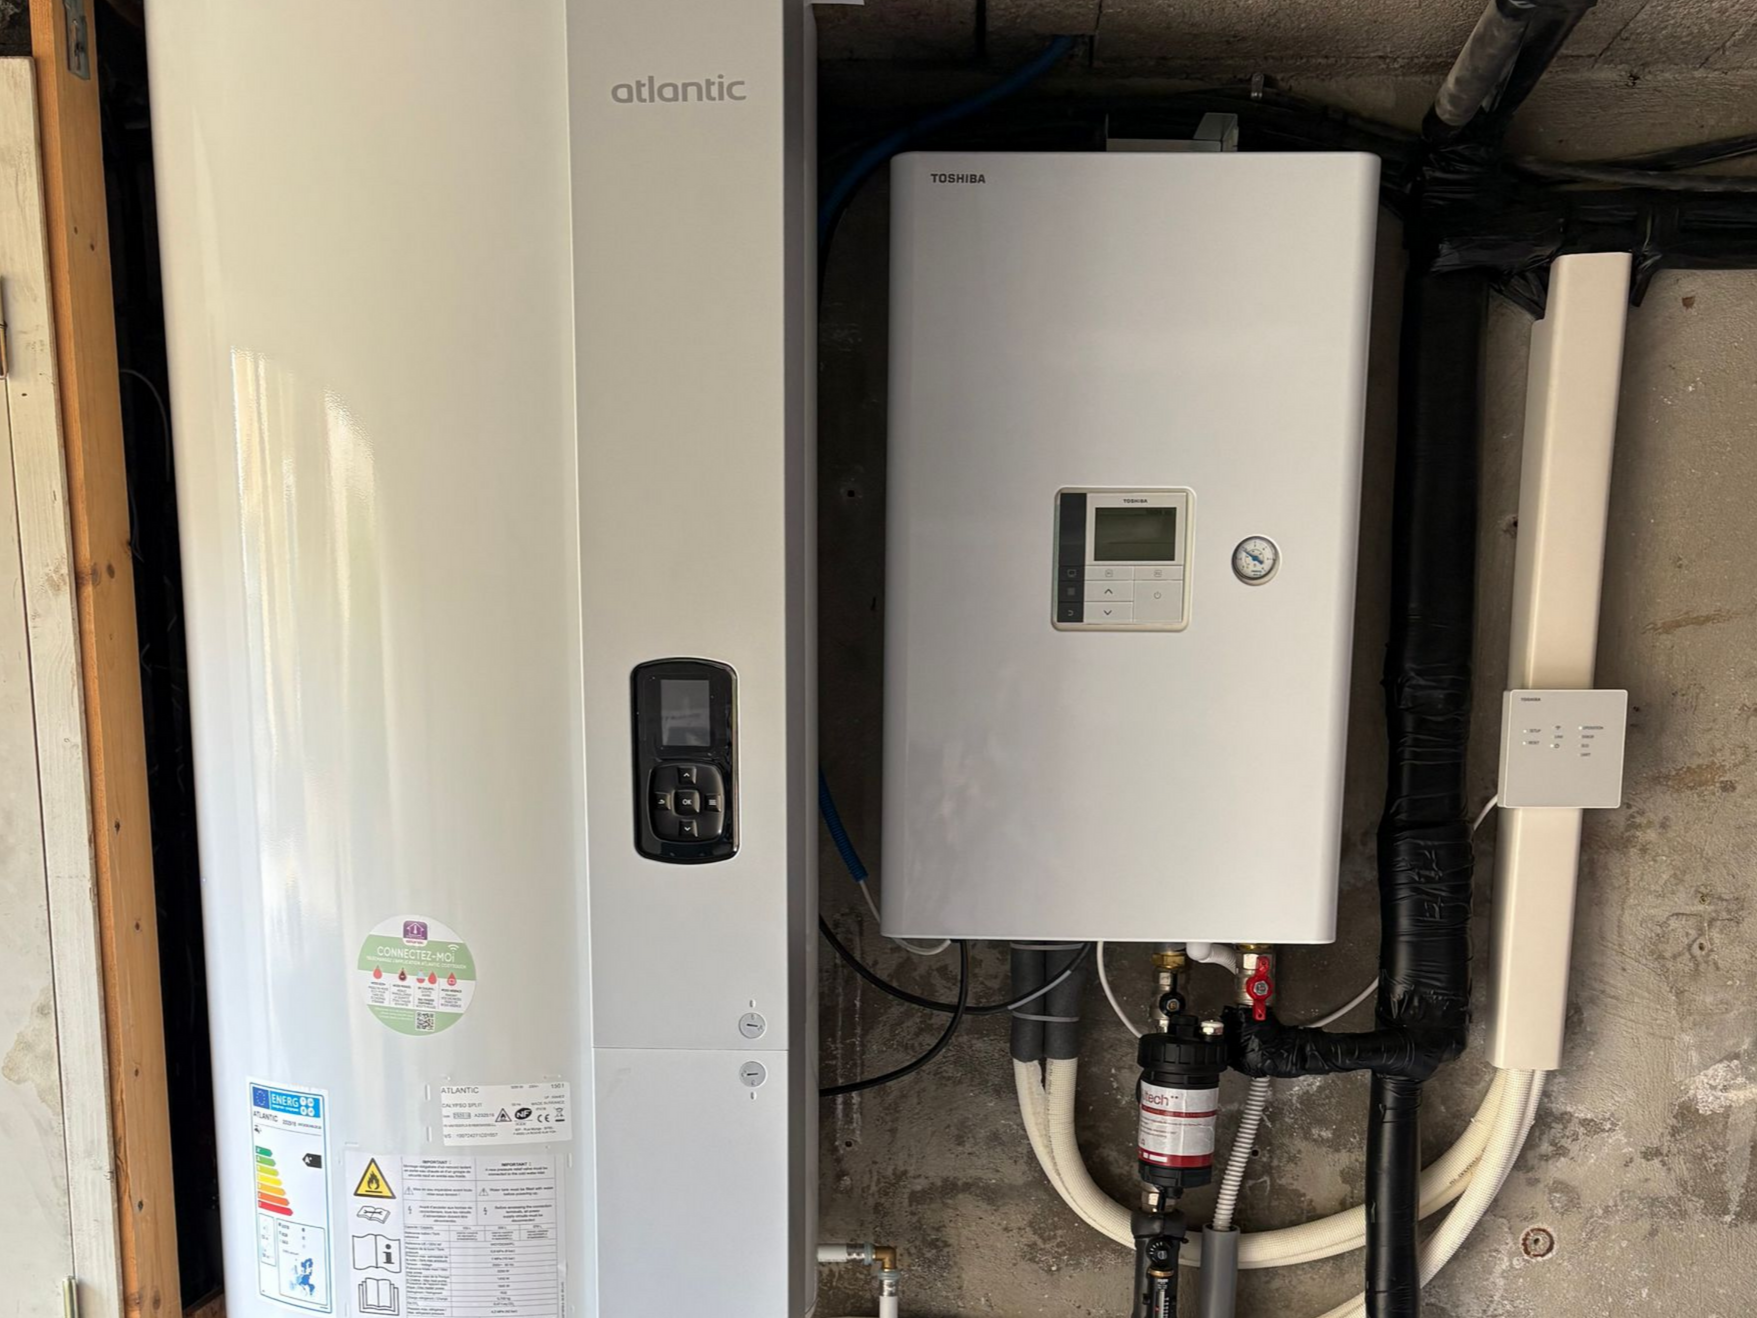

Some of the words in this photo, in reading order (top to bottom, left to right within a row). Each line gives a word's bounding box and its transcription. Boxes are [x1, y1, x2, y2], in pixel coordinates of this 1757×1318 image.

[611, 73, 747, 104] atlantic
[930, 173, 986, 184] TOSHIBA
[272, 1094, 299, 1107] ENERG
[253, 1111, 278, 1122] ATLANTIC
[516, 1110, 532, 1118] NF
[537, 1114, 550, 1123] CE
